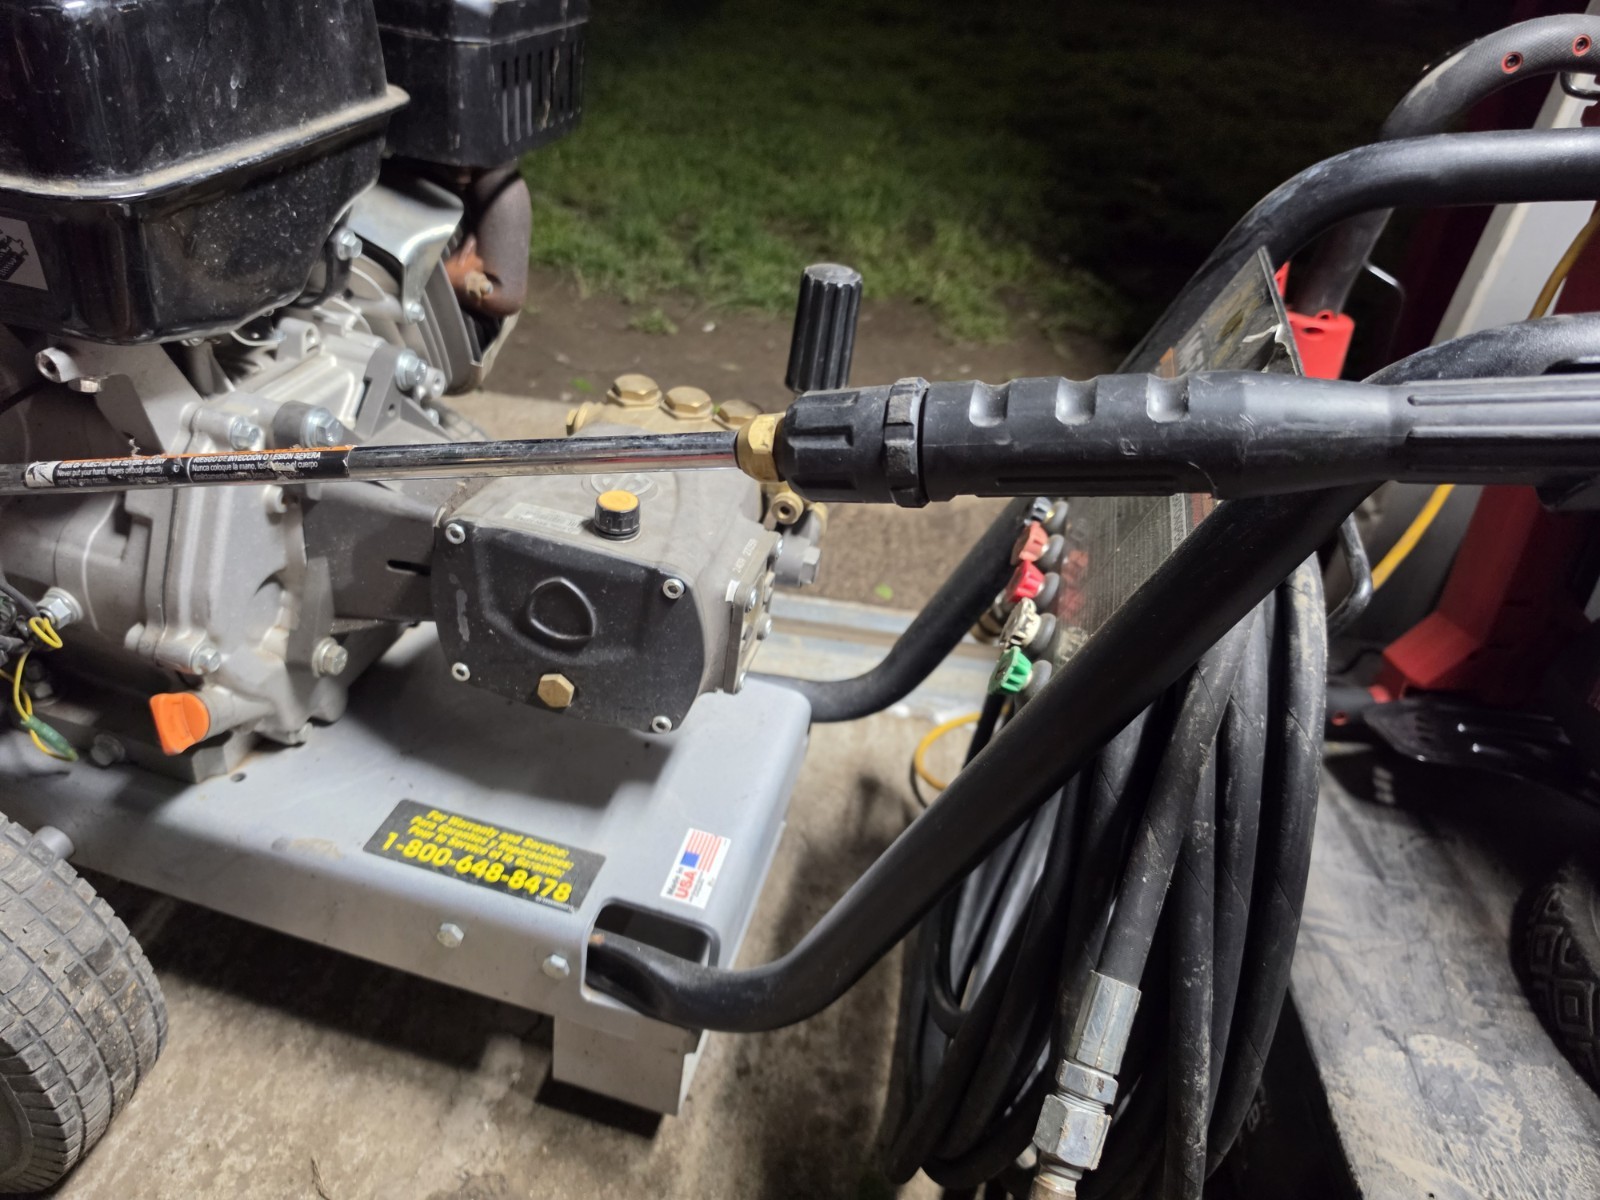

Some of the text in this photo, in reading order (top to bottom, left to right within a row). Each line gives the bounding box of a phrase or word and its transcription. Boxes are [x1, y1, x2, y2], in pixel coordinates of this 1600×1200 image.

[192, 464, 210, 472] Nunca
[210, 463, 232, 473] coloque
[297, 461, 318, 470] cuerpo
[294, 451, 321, 460] SEVERA
[57, 469, 72, 477] Never
[81, 468, 92, 478] your
[107, 466, 124, 476] fingers
[407, 824, 436, 839] Pour
[434, 832, 448, 844] le
[446, 836, 489, 856] Service
[488, 849, 503, 860] et
[410, 815, 437, 830] Para
[488, 839, 498, 849] y
[498, 841, 575, 871] Reparaciones:
[426, 809, 570, 859] For Warranty and Service:
[382, 831, 573, 903] 1-800-648-8478
[666, 875, 680, 895] Made
[674, 871, 698, 899] USA
